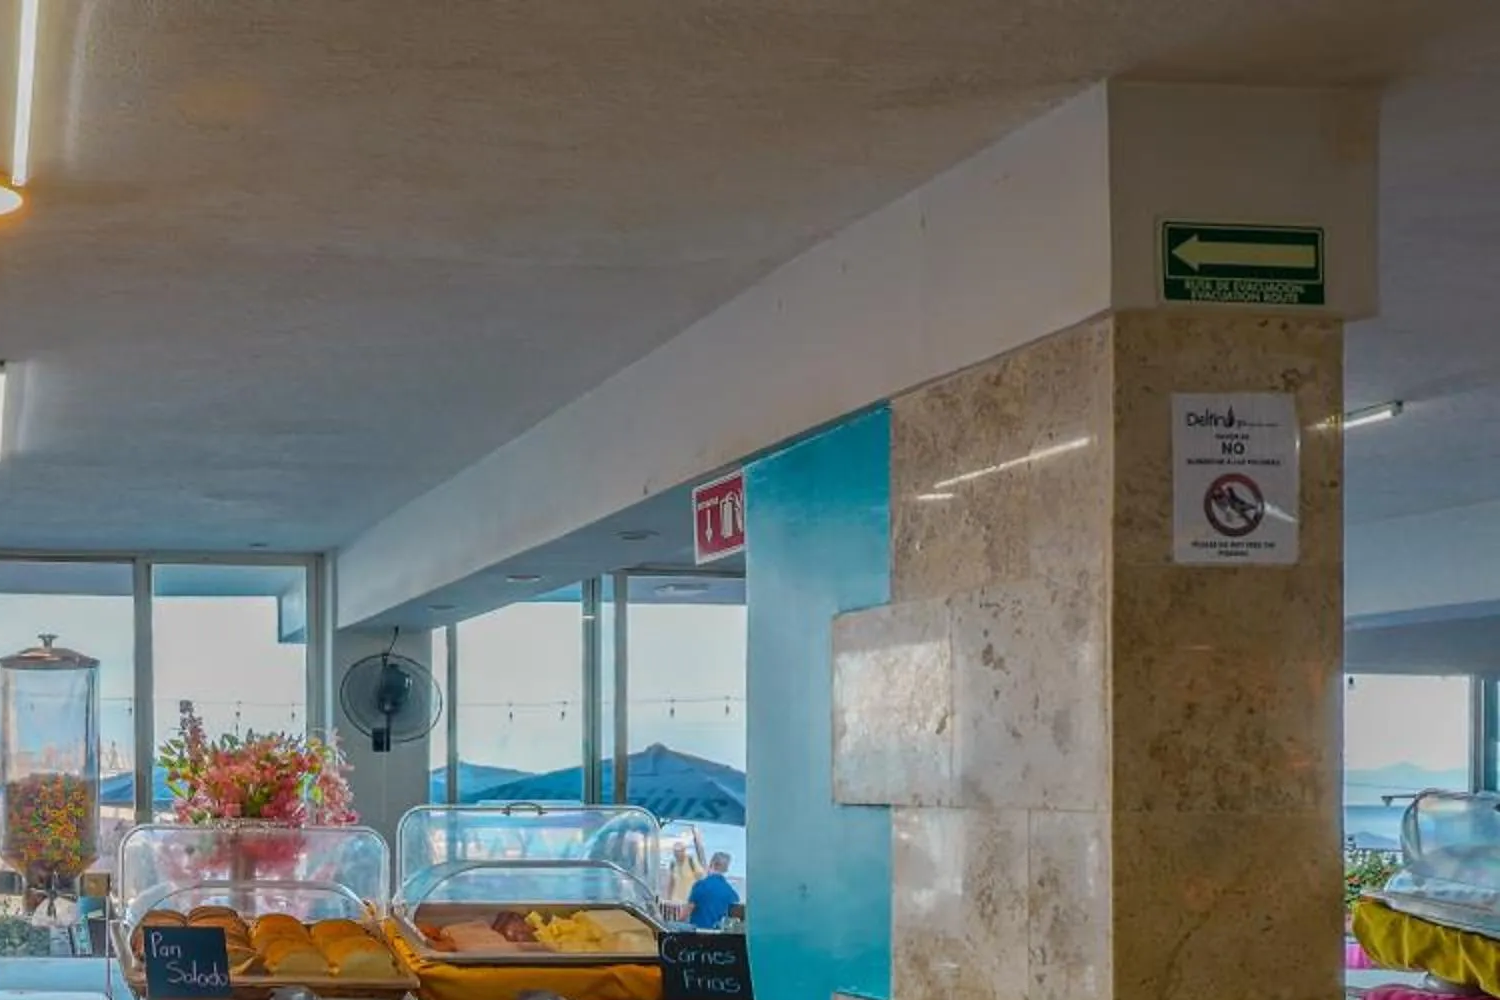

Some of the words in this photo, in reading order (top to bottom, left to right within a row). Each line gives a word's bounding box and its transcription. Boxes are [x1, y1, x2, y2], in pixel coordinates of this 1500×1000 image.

[1221, 442, 1245, 455] NO
[151, 931, 181, 959] Pan
[661, 935, 737, 966] Carnes
[682, 967, 741, 993] Frias
